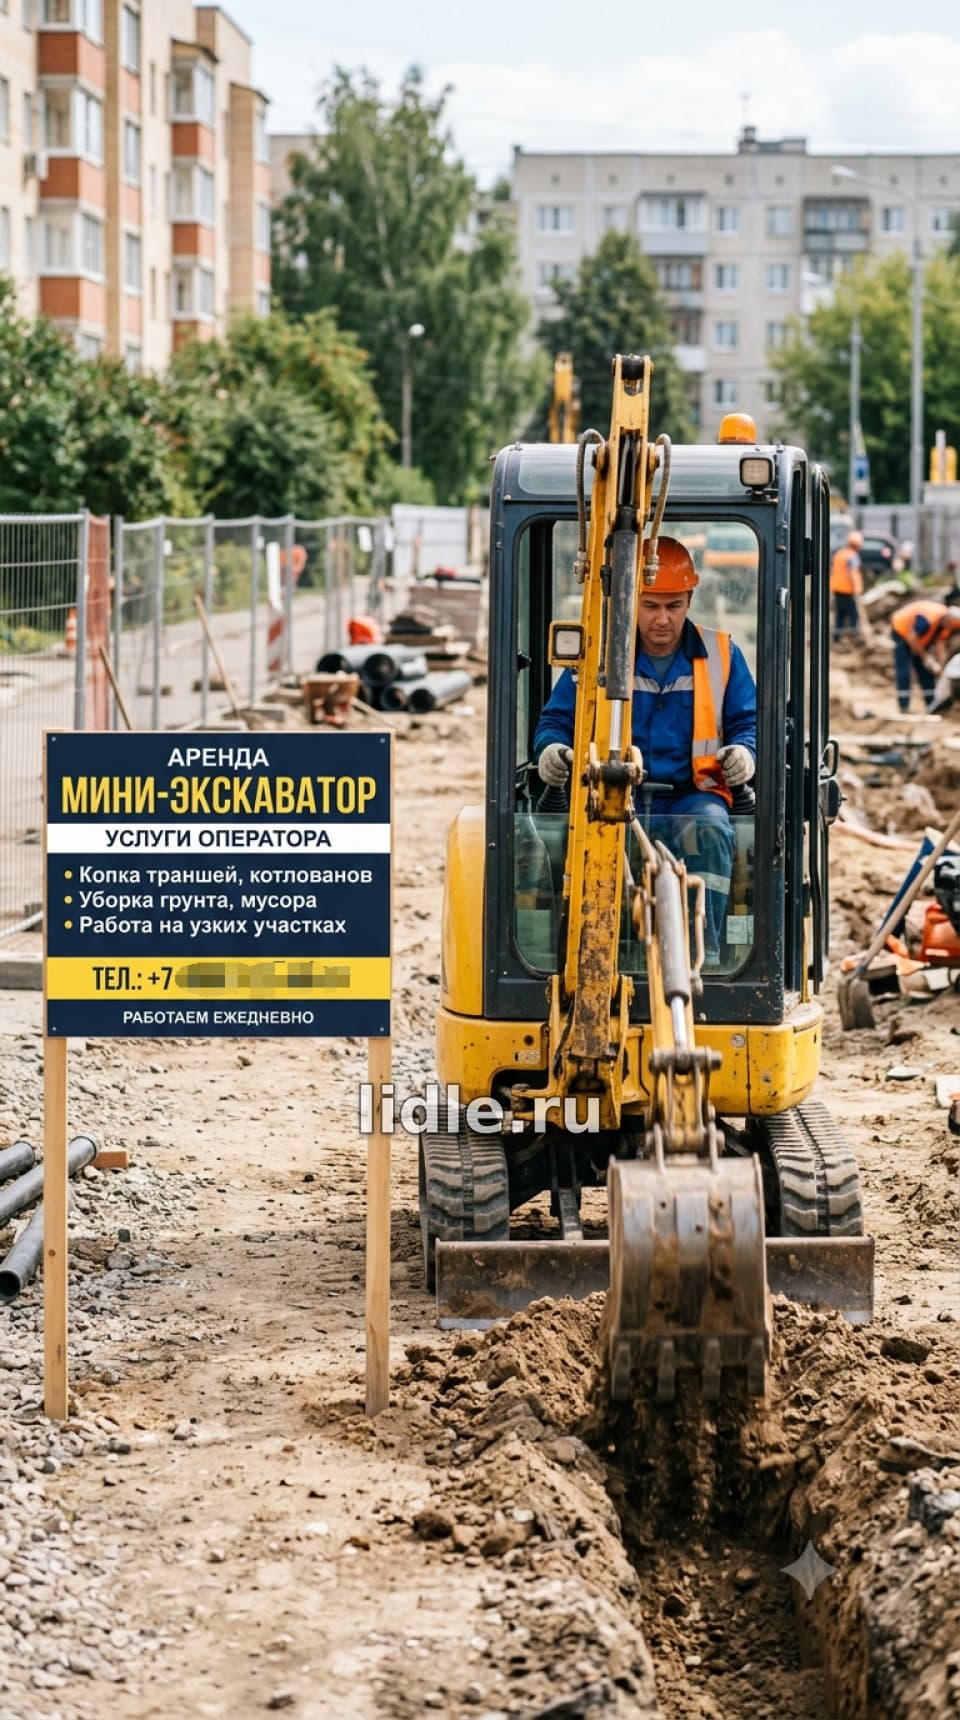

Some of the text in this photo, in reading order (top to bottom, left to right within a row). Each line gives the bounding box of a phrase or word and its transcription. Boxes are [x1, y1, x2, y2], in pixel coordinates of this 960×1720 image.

[167, 748, 270, 770] АРЕНДА
[62, 776, 377, 814] МИНИ-ЭКСКАВАТОР
[105, 830, 332, 848] УСЛУГИ ОПЕРАТОРА
[79, 865, 373, 887] Копка траншей, котлованов
[79, 890, 317, 913] Уборка грунта, мусора
[79, 916, 347, 938] Работа на узких участках
[92, 967, 142, 991] ТЕЛ.:
[123, 1010, 315, 1026] РАБОТАЕМ ЕЖЕДНЕВНО
